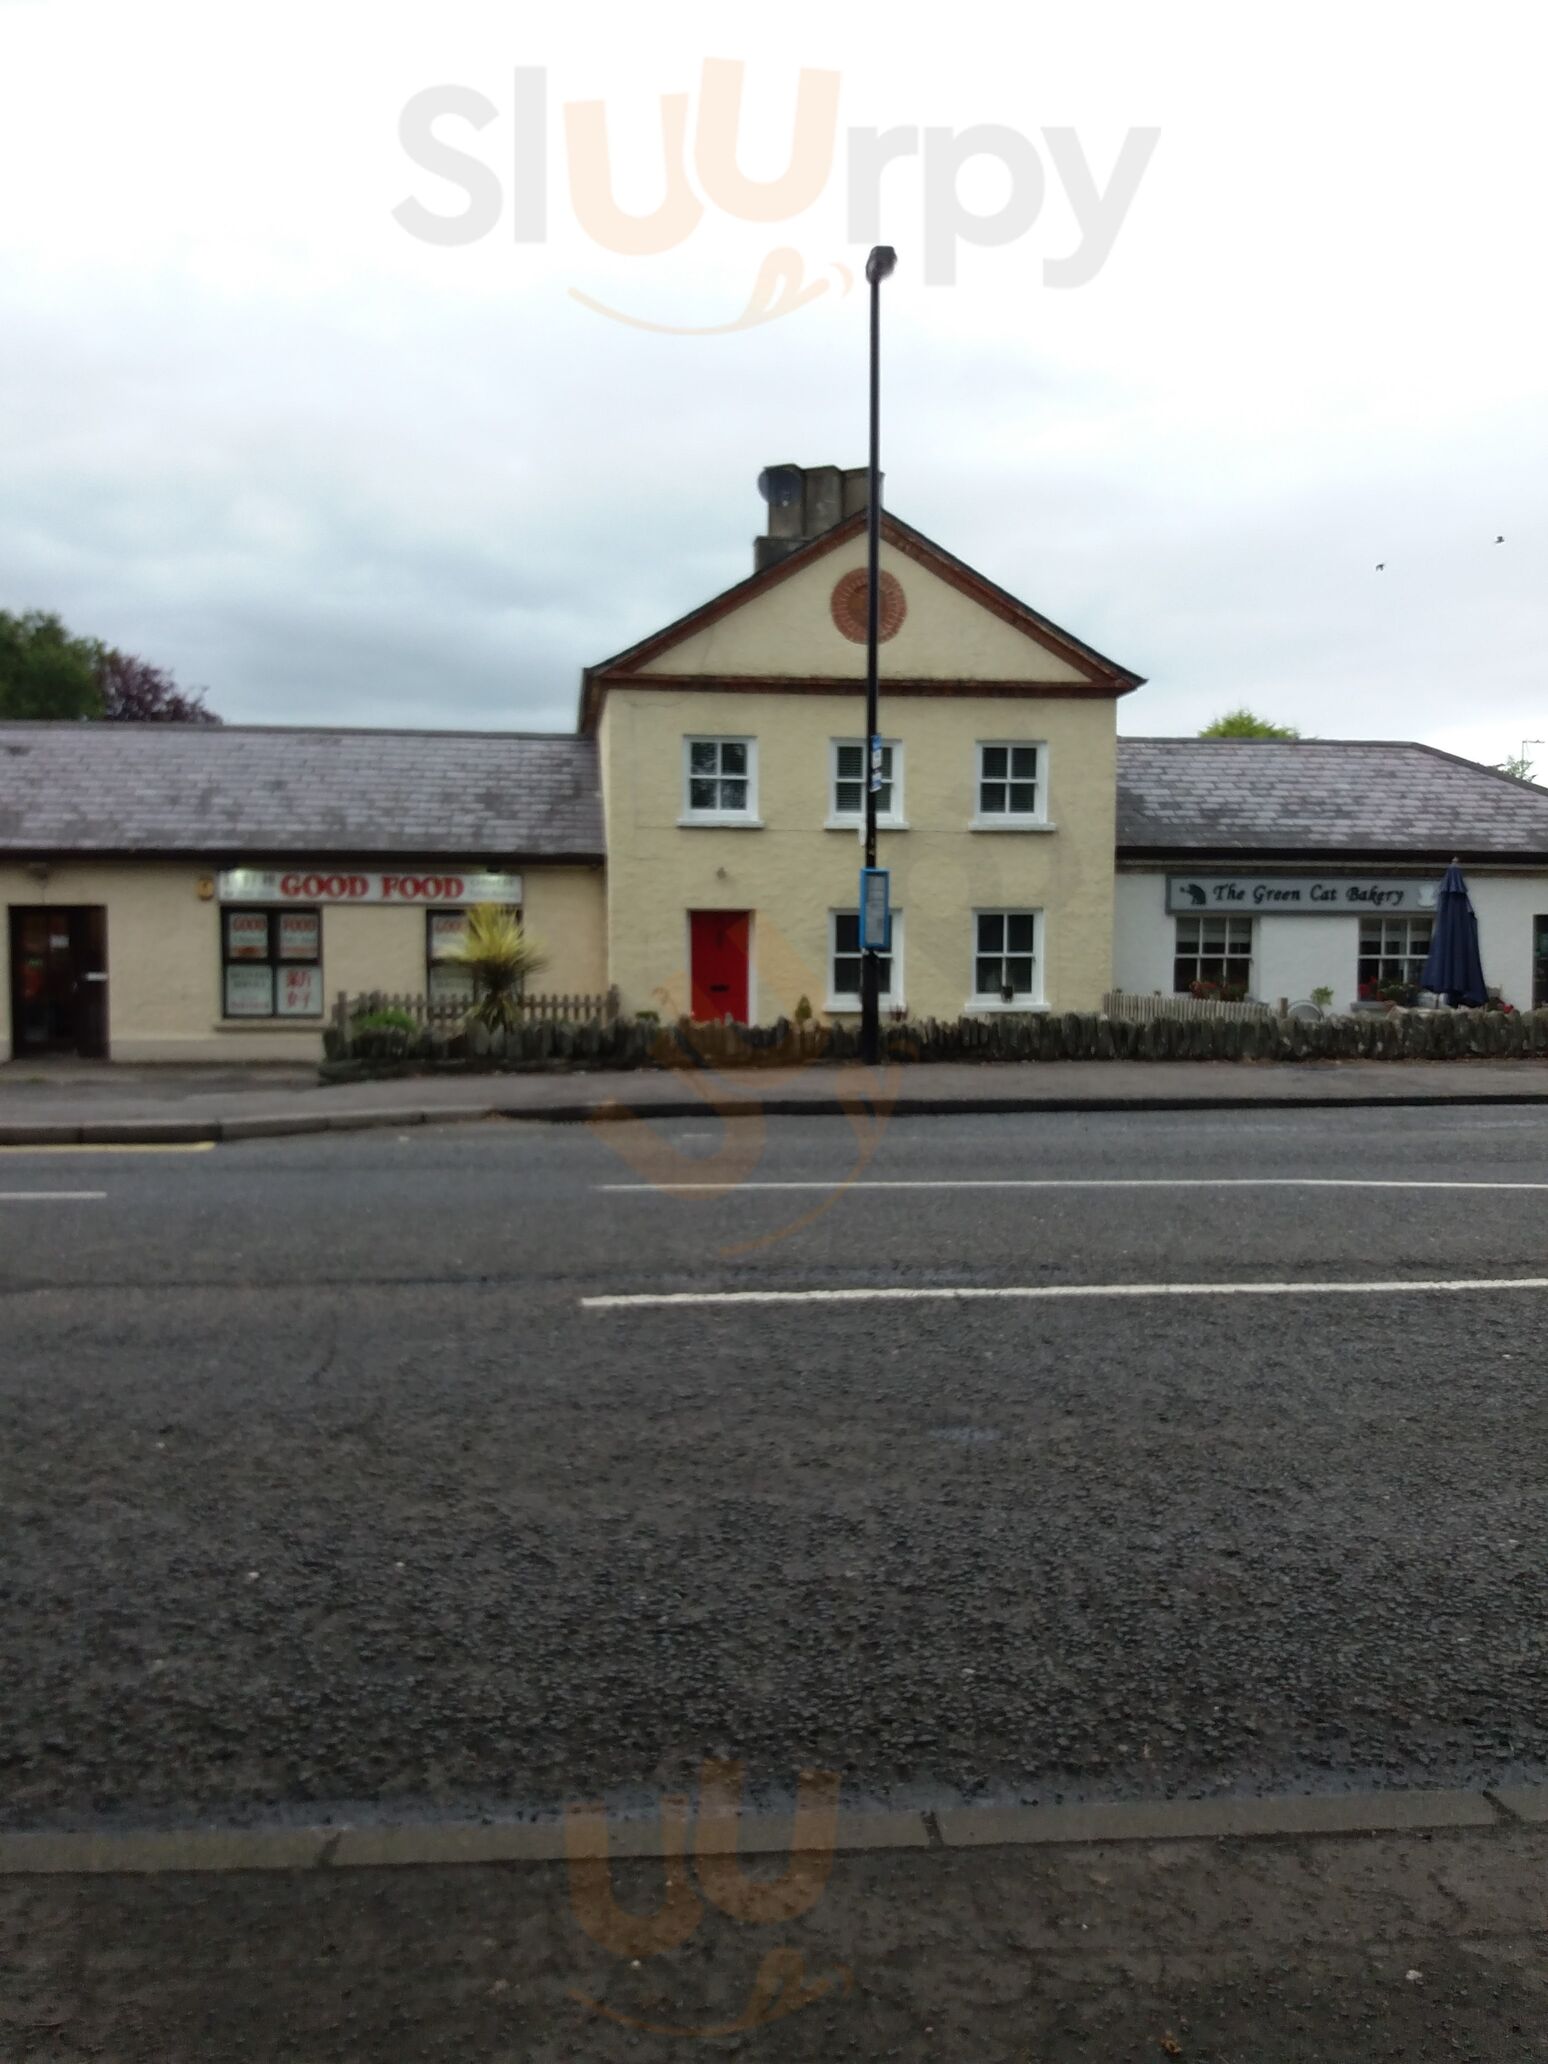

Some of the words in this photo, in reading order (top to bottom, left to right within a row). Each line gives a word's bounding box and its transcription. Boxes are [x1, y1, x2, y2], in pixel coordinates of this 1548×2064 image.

[280, 874, 369, 899] GOOD
[380, 875, 465, 899] FOOD
[1212, 883, 1246, 902] The
[1252, 885, 1300, 905] Green
[1309, 883, 1337, 902] Cat
[1345, 885, 1405, 907] Bakery
